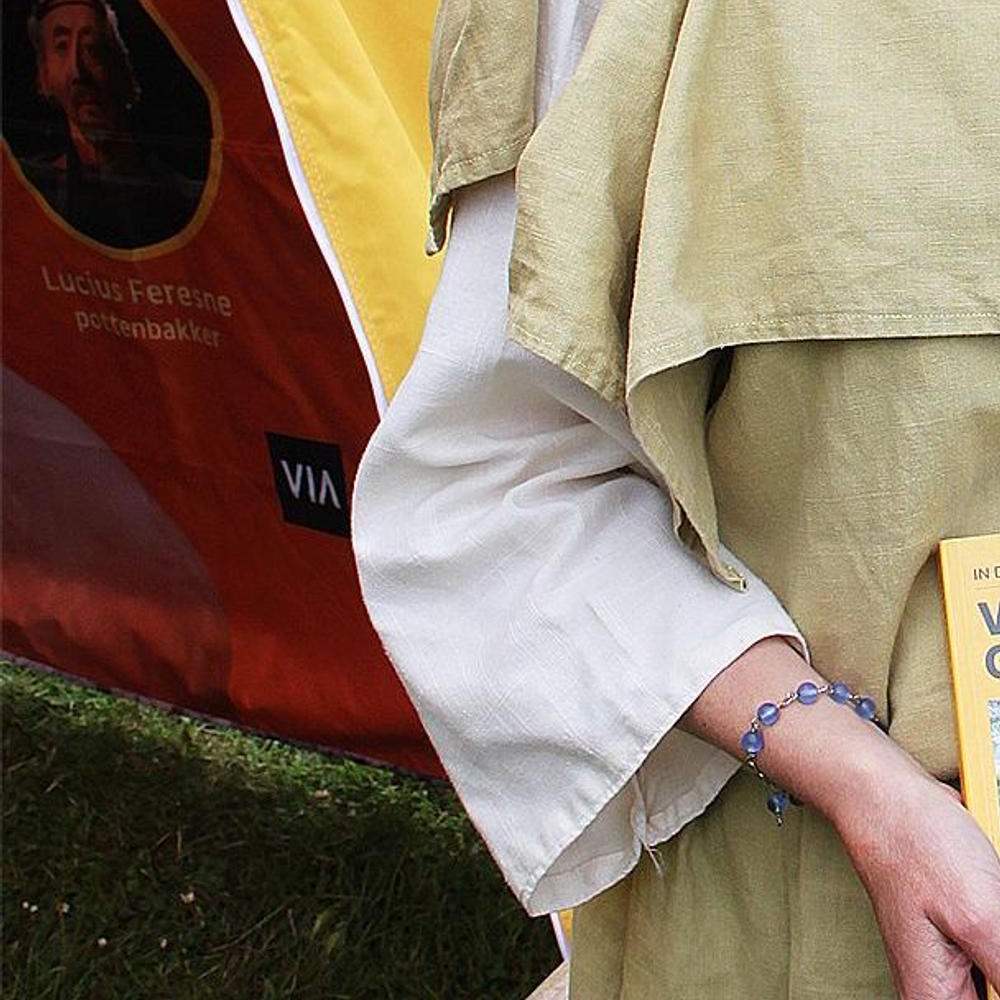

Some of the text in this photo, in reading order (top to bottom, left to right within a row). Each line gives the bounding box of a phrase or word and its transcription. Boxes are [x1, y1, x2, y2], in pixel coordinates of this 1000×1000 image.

[41, 265, 232, 317] Lucius Feresne
[75, 310, 221, 347] pottenbakker
[281, 459, 341, 509] VIA
[973, 568, 990, 580] IN
